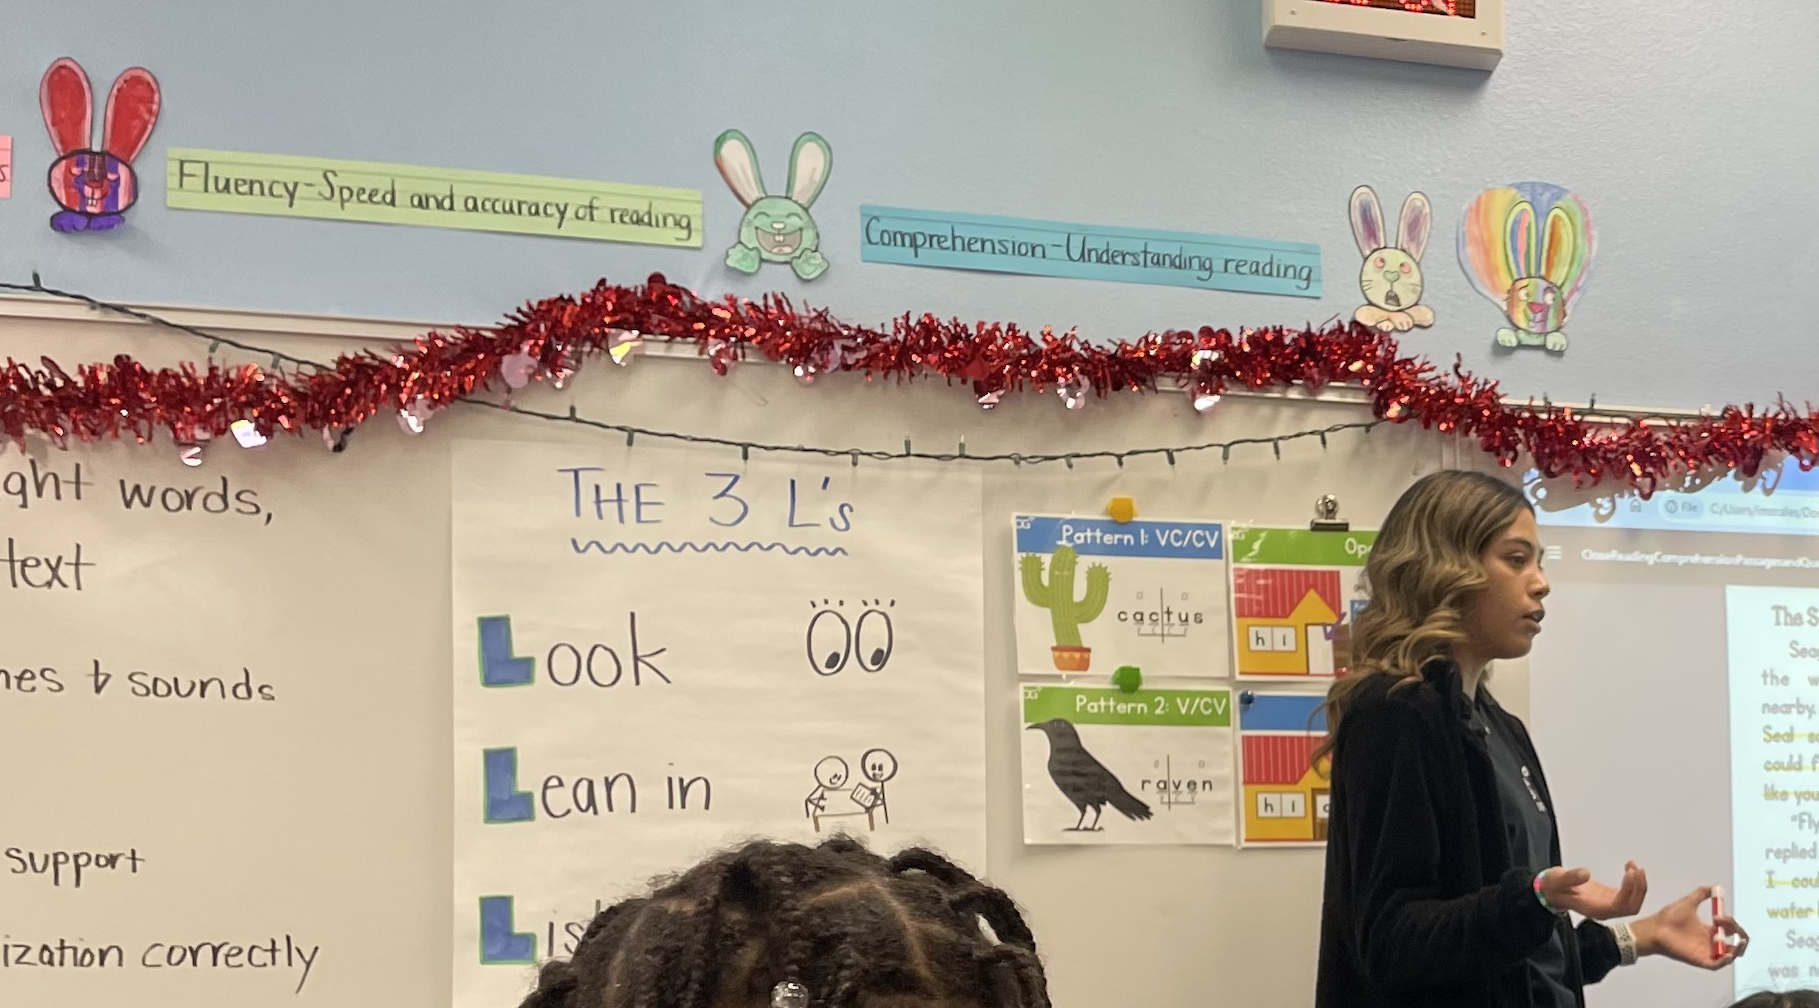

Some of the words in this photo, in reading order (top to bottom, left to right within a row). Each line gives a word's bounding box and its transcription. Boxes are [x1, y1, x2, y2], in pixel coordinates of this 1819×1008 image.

[409, 188, 457, 214] and
[463, 191, 568, 228] accuracy
[574, 193, 598, 223] of
[608, 200, 693, 240] reading
[1223, 254, 1313, 290] reading
[119, 476, 273, 526] words,
[557, 467, 665, 525] THE
[704, 473, 749, 527] 3
[788, 477, 854, 533] L's
[1057, 524, 1135, 546] Pattern
[1155, 528, 1220, 549] VC/CV
[1, 538, 96, 590] text
[1117, 606, 1204, 625] cactus
[1771, 605, 1804, 628] The
[477, 613, 672, 688] Look
[128, 667, 276, 701] sounds
[1761, 668, 1790, 687] the
[1075, 695, 1148, 715] Pattern
[1176, 697, 1226, 715] V/CV
[1761, 698, 1816, 720] nearby.
[1762, 725, 1795, 744] Seal
[1763, 755, 1804, 773] could
[477, 747, 637, 824] Lean
[667, 762, 712, 811] in
[1141, 778, 1213, 791] raven
[1763, 783, 1789, 801] like
[1765, 841, 1818, 864] replied
[4, 847, 146, 888] support
[1765, 871, 1776, 889] I
[1767, 902, 1813, 920] water
[2, 936, 124, 968] ization
[142, 934, 319, 994] correctly
[1767, 963, 1798, 979] was
